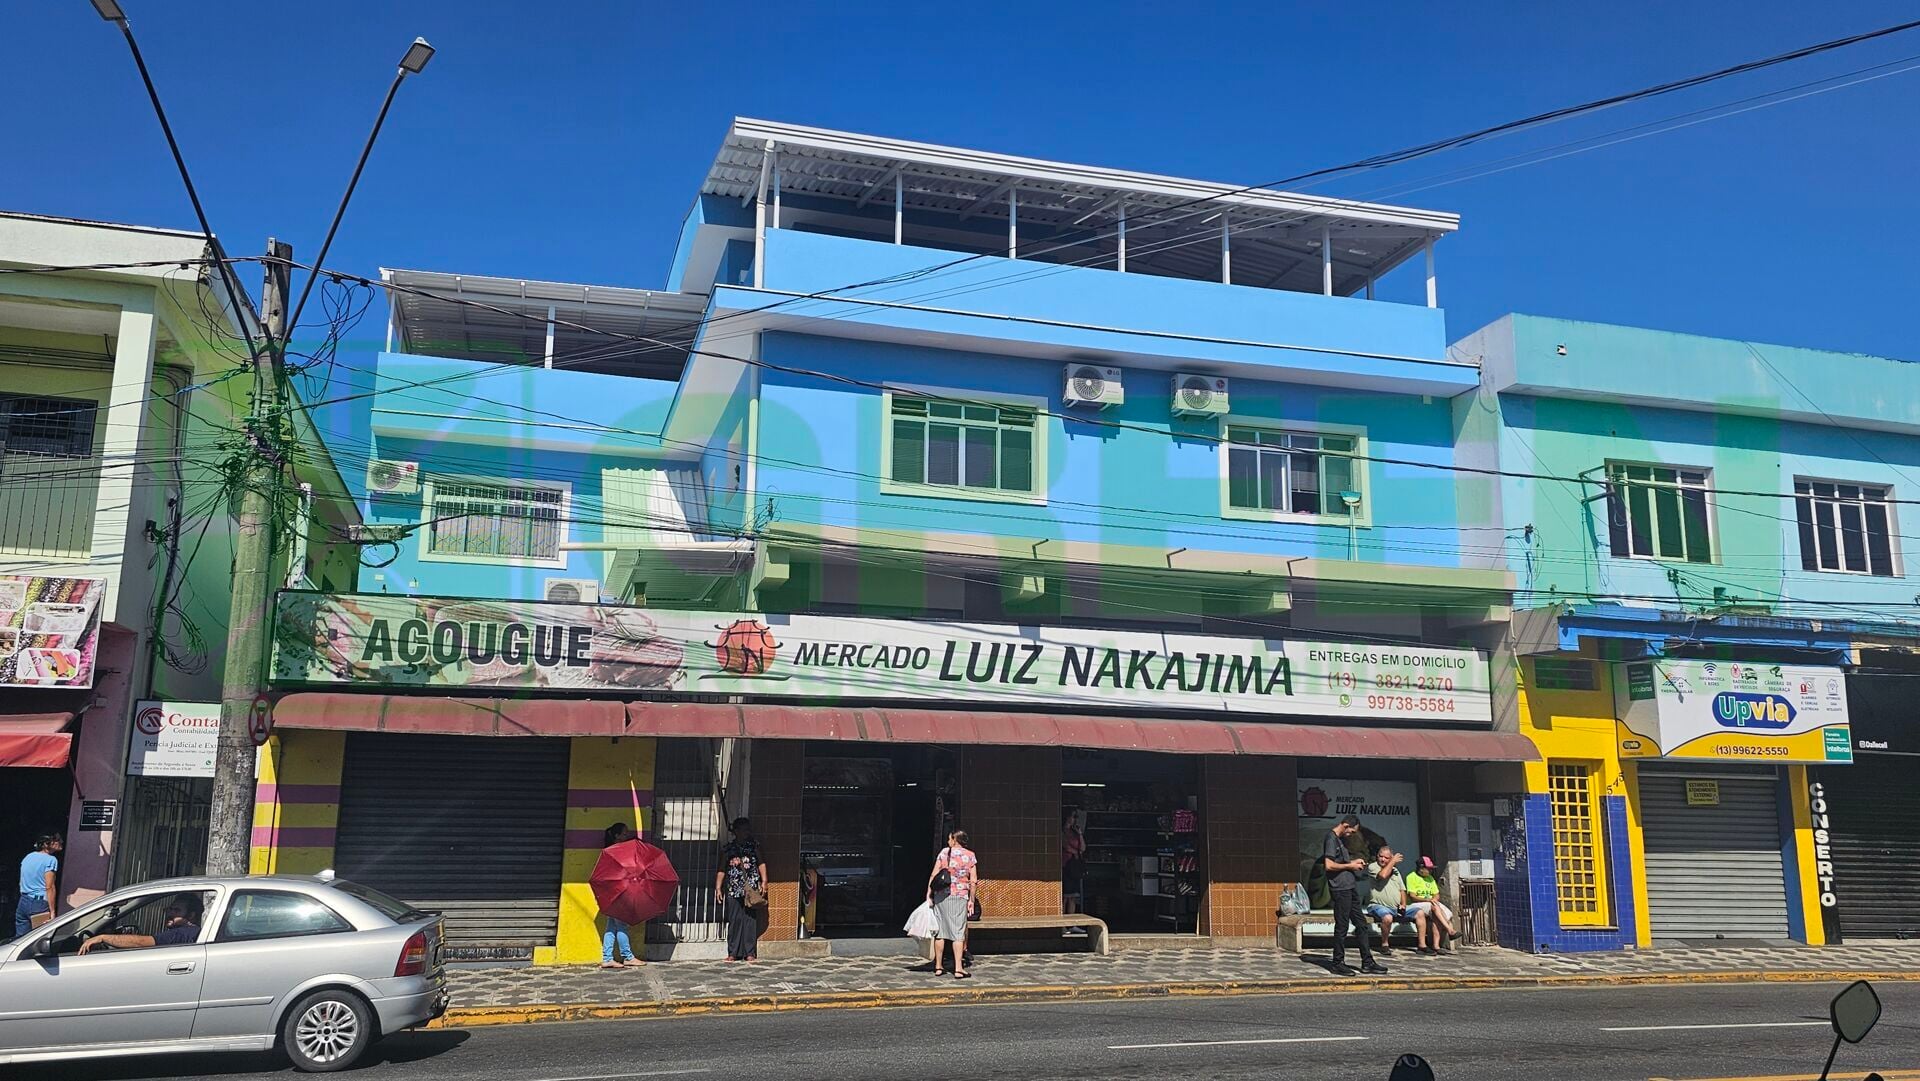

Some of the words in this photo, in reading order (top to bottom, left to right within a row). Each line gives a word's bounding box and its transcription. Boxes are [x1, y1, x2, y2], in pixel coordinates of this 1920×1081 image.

[361, 618, 593, 674] AÇOUGUE
[794, 642, 931, 670] MERCADO
[939, 641, 1042, 685] LUIZ
[1059, 646, 1294, 697] NAKAJIMA
[1309, 650, 1378, 665] ENTREGAS
[1381, 654, 1400, 666] EM
[1403, 655, 1466, 670] DOMICÍLIO
[1327, 672, 1358, 691] (13)
[1375, 674, 1453, 692] 3821-2370
[1367, 695, 1455, 713] 99738-5584
[1718, 694, 1790, 726] Upvia
[1336, 795, 1365, 804] MERCADO
[1335, 804, 1358, 815] LUIZ
[1360, 804, 1411, 816] NAKAJIMA
[1809, 782, 1837, 908] CONSERTO
